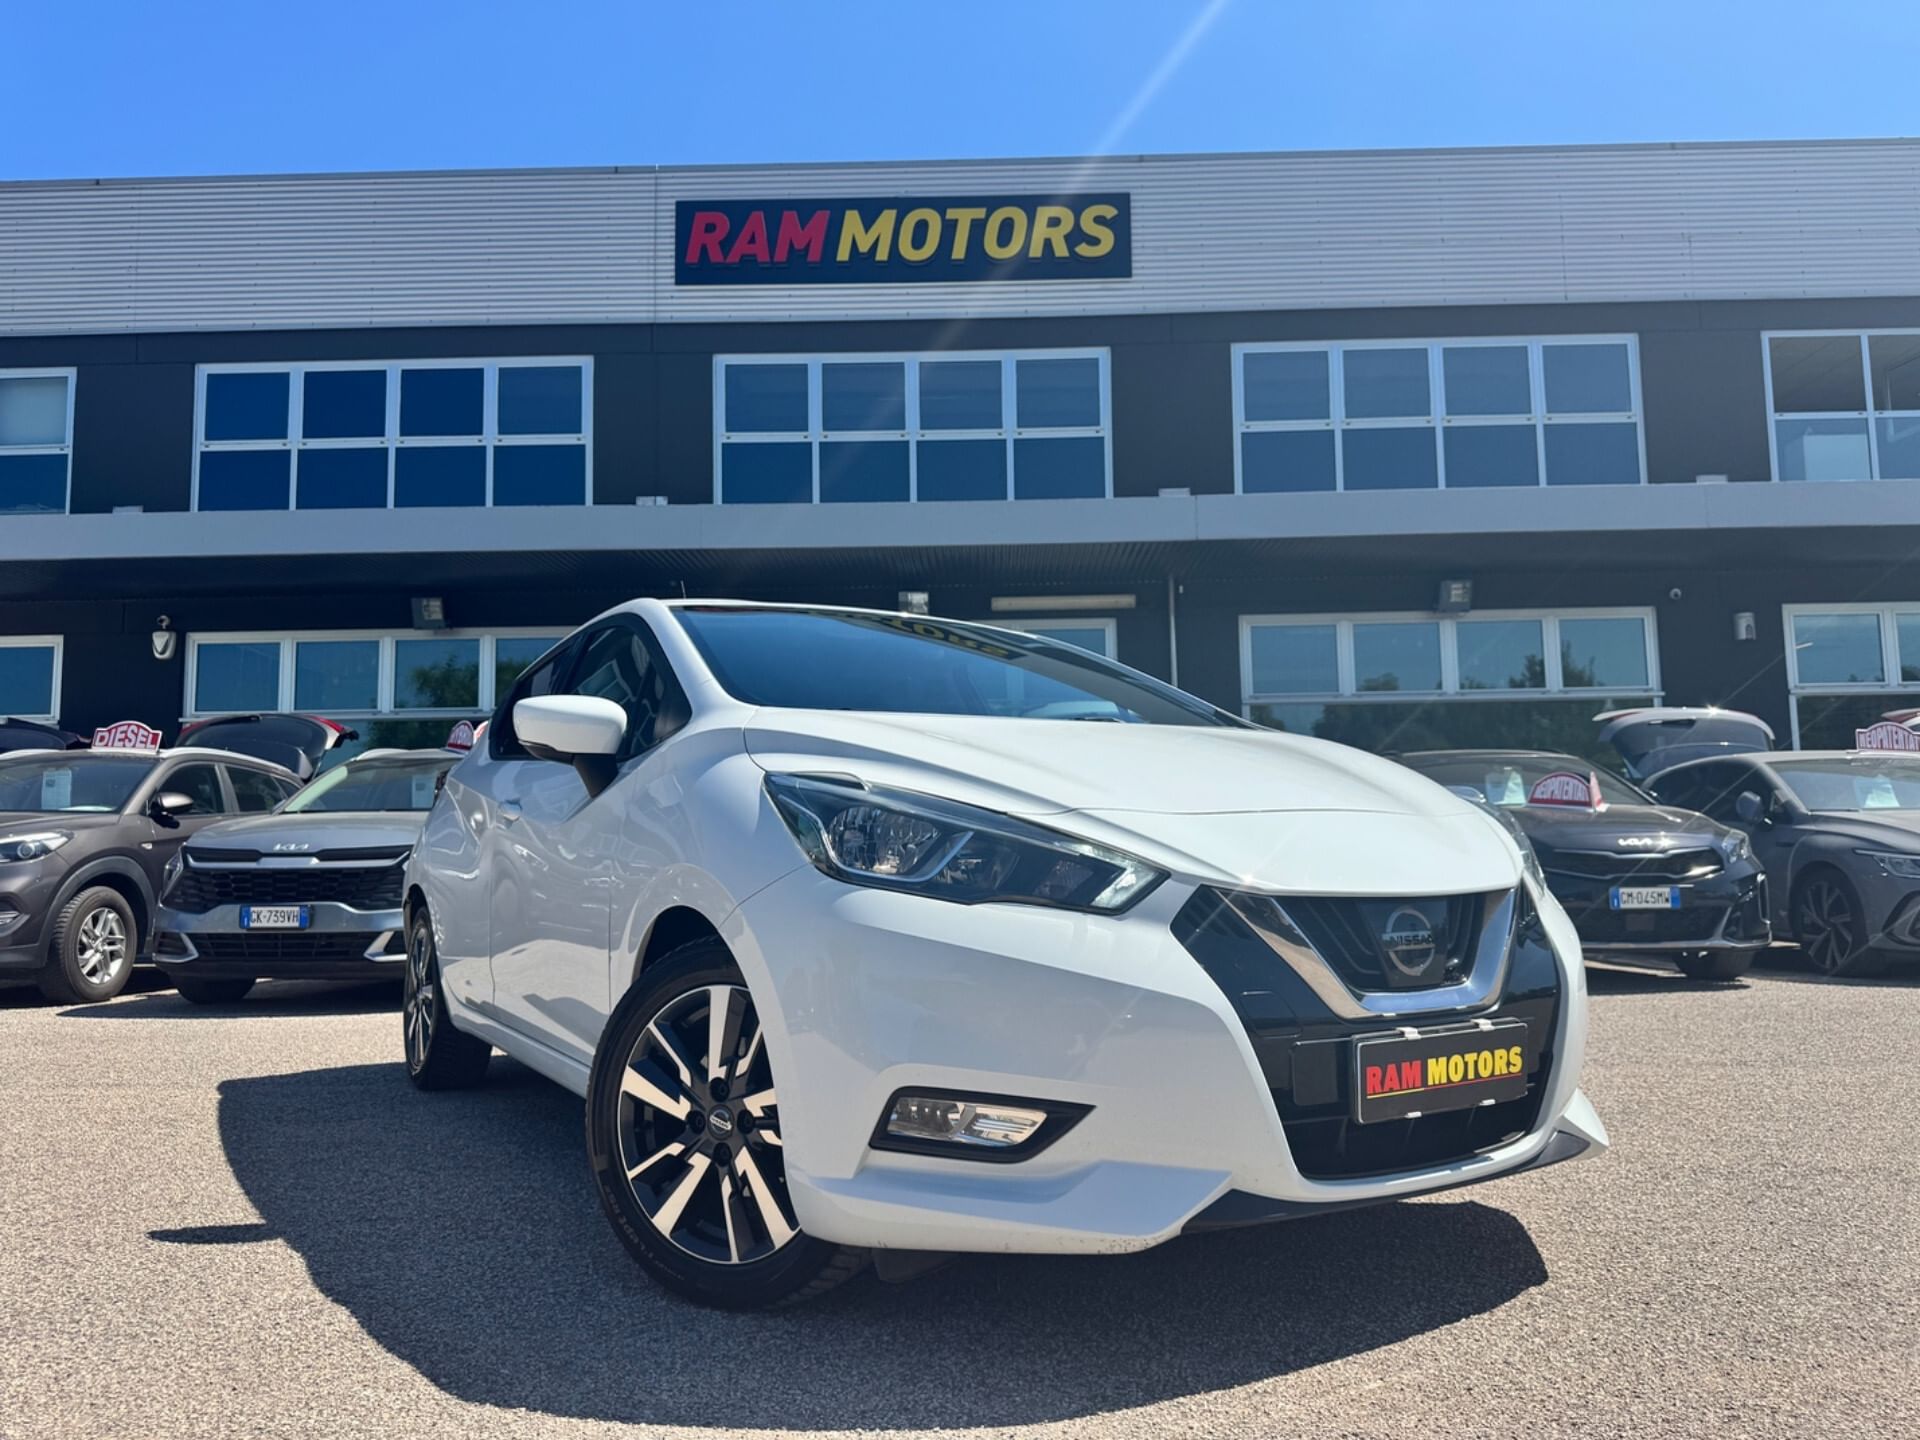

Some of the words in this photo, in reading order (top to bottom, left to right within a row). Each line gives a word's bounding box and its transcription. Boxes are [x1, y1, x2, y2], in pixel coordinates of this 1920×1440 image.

[685, 210, 829, 265] RAM
[835, 204, 1118, 263] MOTORS
[95, 724, 156, 749] DIESEL
[1366, 1060, 1422, 1094] RAM
[1427, 1046, 1523, 1085] MOTORS
